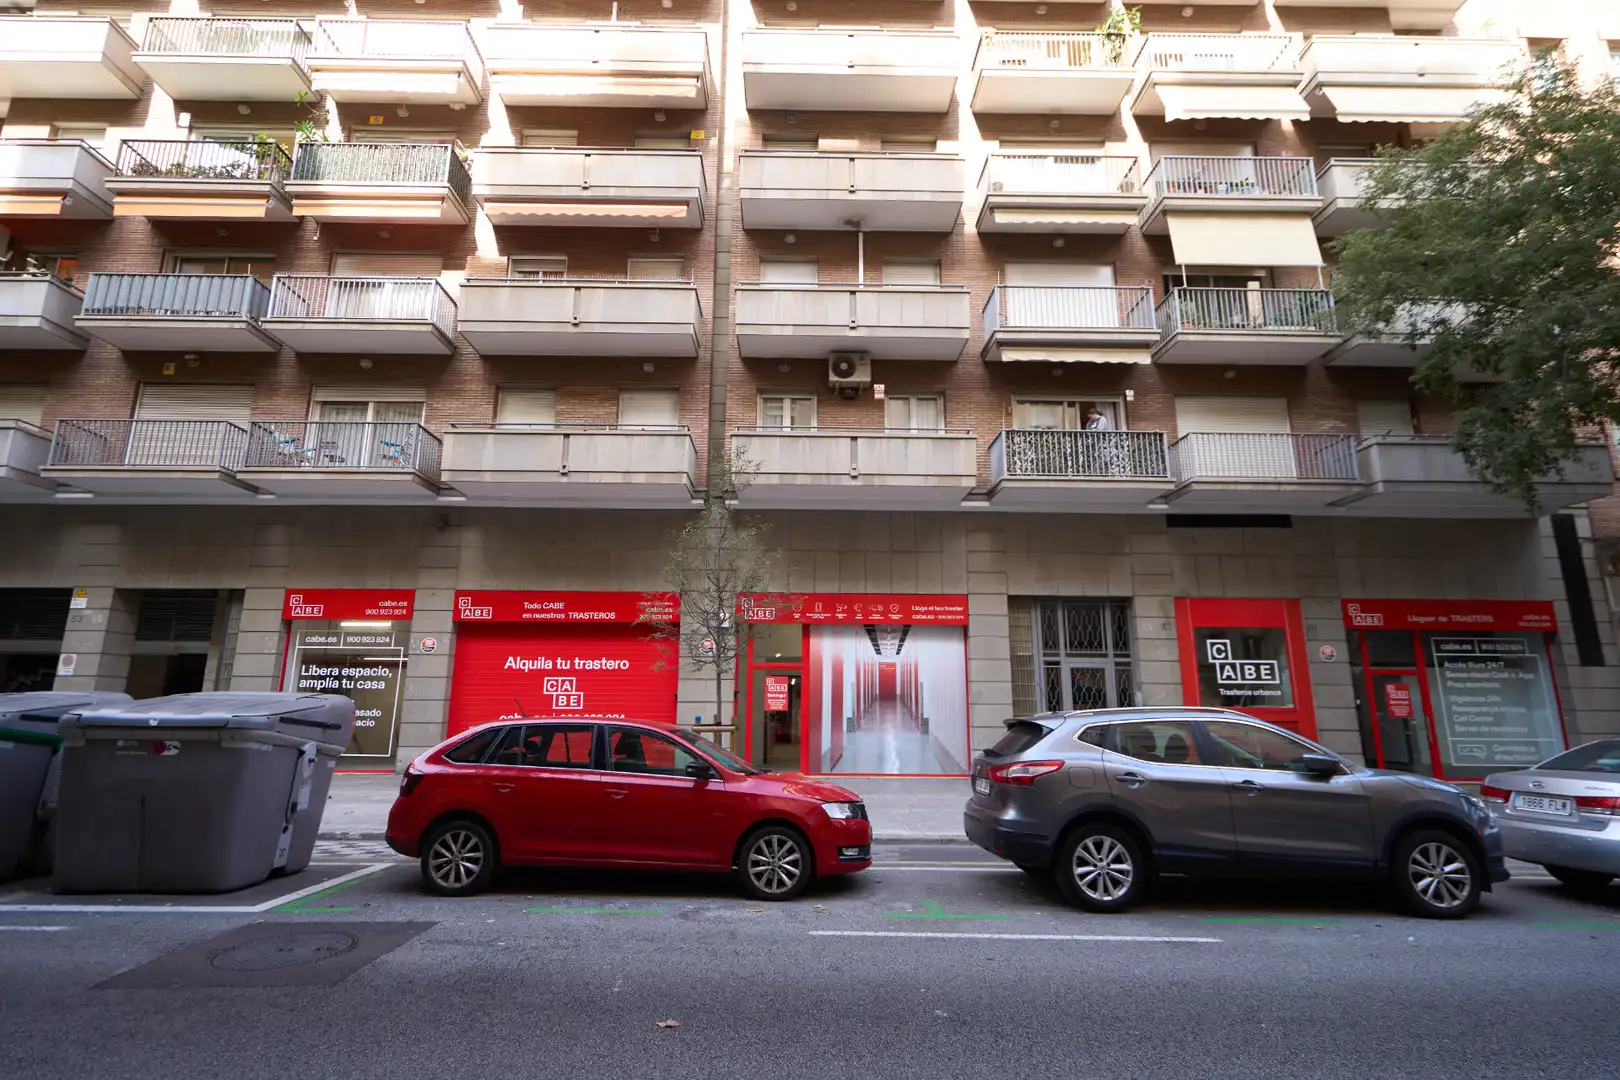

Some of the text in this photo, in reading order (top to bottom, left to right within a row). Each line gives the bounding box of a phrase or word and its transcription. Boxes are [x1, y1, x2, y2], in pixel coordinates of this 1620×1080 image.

[71, 615, 83, 623] 53
[568, 612, 616, 620] TRASTEROS
[305, 635, 338, 643] cabe.es
[504, 656, 629, 671] Alquila tu trastero
[301, 665, 393, 679] Libera espacio,
[299, 678, 386, 691] amplía tu casa
[1219, 688, 1281, 696] Trasteros urbanos
[355, 709, 382, 717] asado
[354, 719, 375, 727] acio
